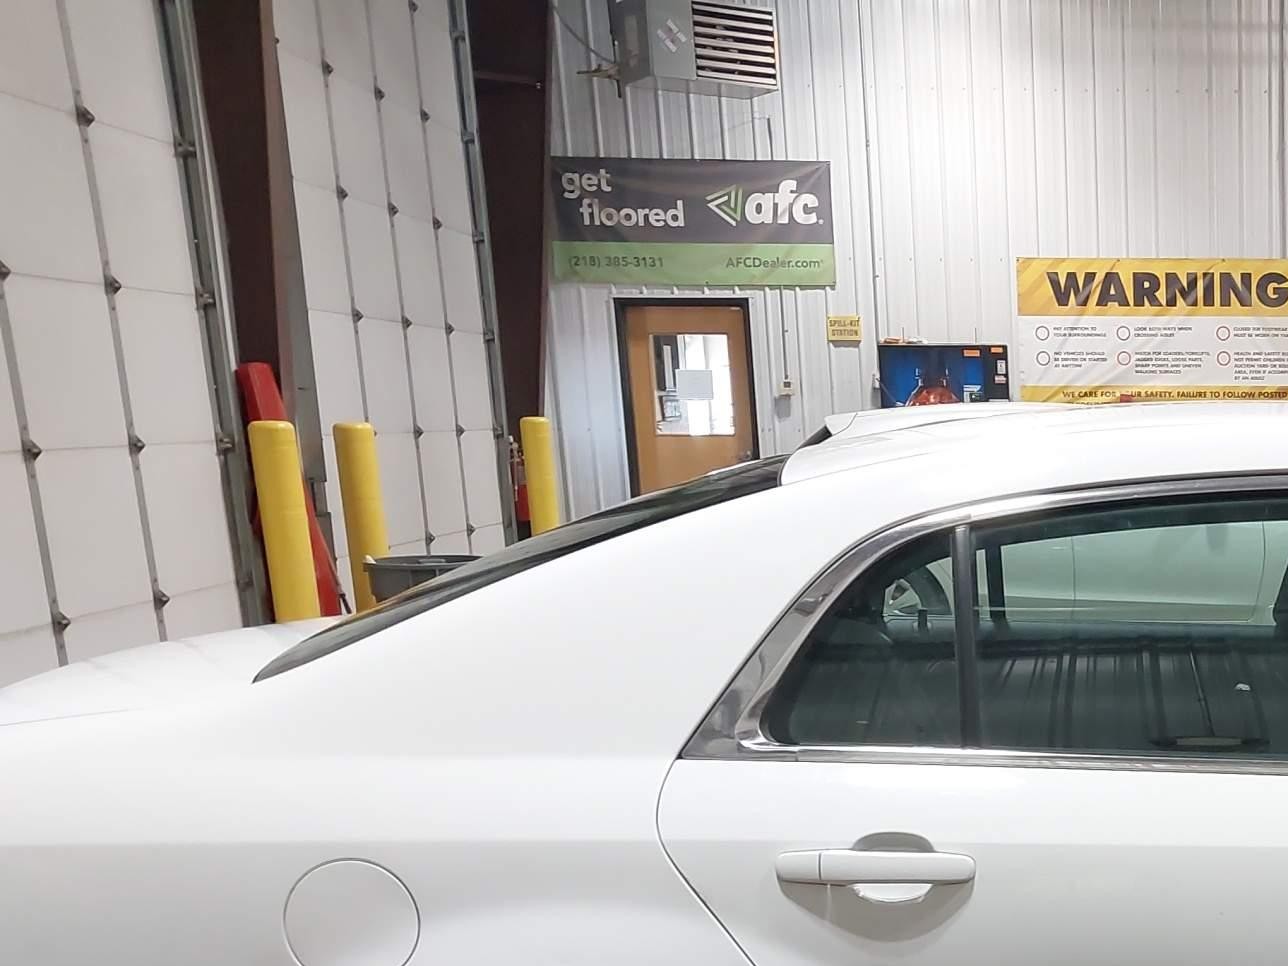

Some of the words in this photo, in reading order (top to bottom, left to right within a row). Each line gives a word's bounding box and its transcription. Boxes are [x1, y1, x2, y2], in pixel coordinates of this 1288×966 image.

[561, 168, 612, 199] get
[579, 198, 686, 228] floored
[568, 256, 601, 268] (218)
[605, 256, 664, 268] 385-3131
[725, 257, 820, 269] AFCDealer.com
[832, 328, 859, 337] STATION
